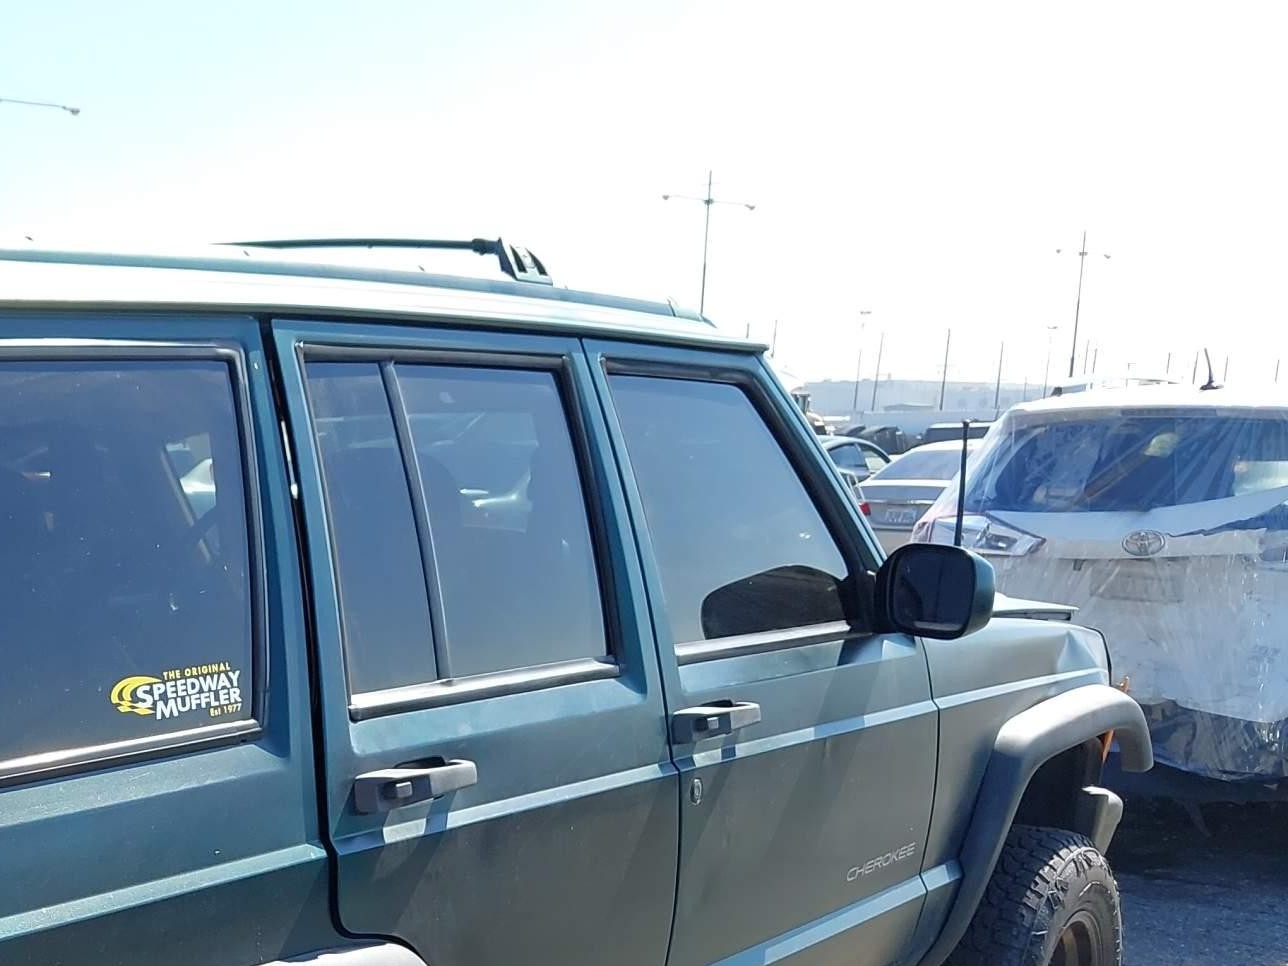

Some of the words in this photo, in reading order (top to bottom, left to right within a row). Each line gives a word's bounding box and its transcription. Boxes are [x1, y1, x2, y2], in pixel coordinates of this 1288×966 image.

[162, 669, 181, 680] THE
[184, 661, 231, 677] ORIGINAL
[136, 670, 241, 706] SPEEDWAY
[156, 687, 242, 720] MUFFLER
[223, 703, 242, 715] 1977
[846, 841, 917, 882] CHEROKEE
